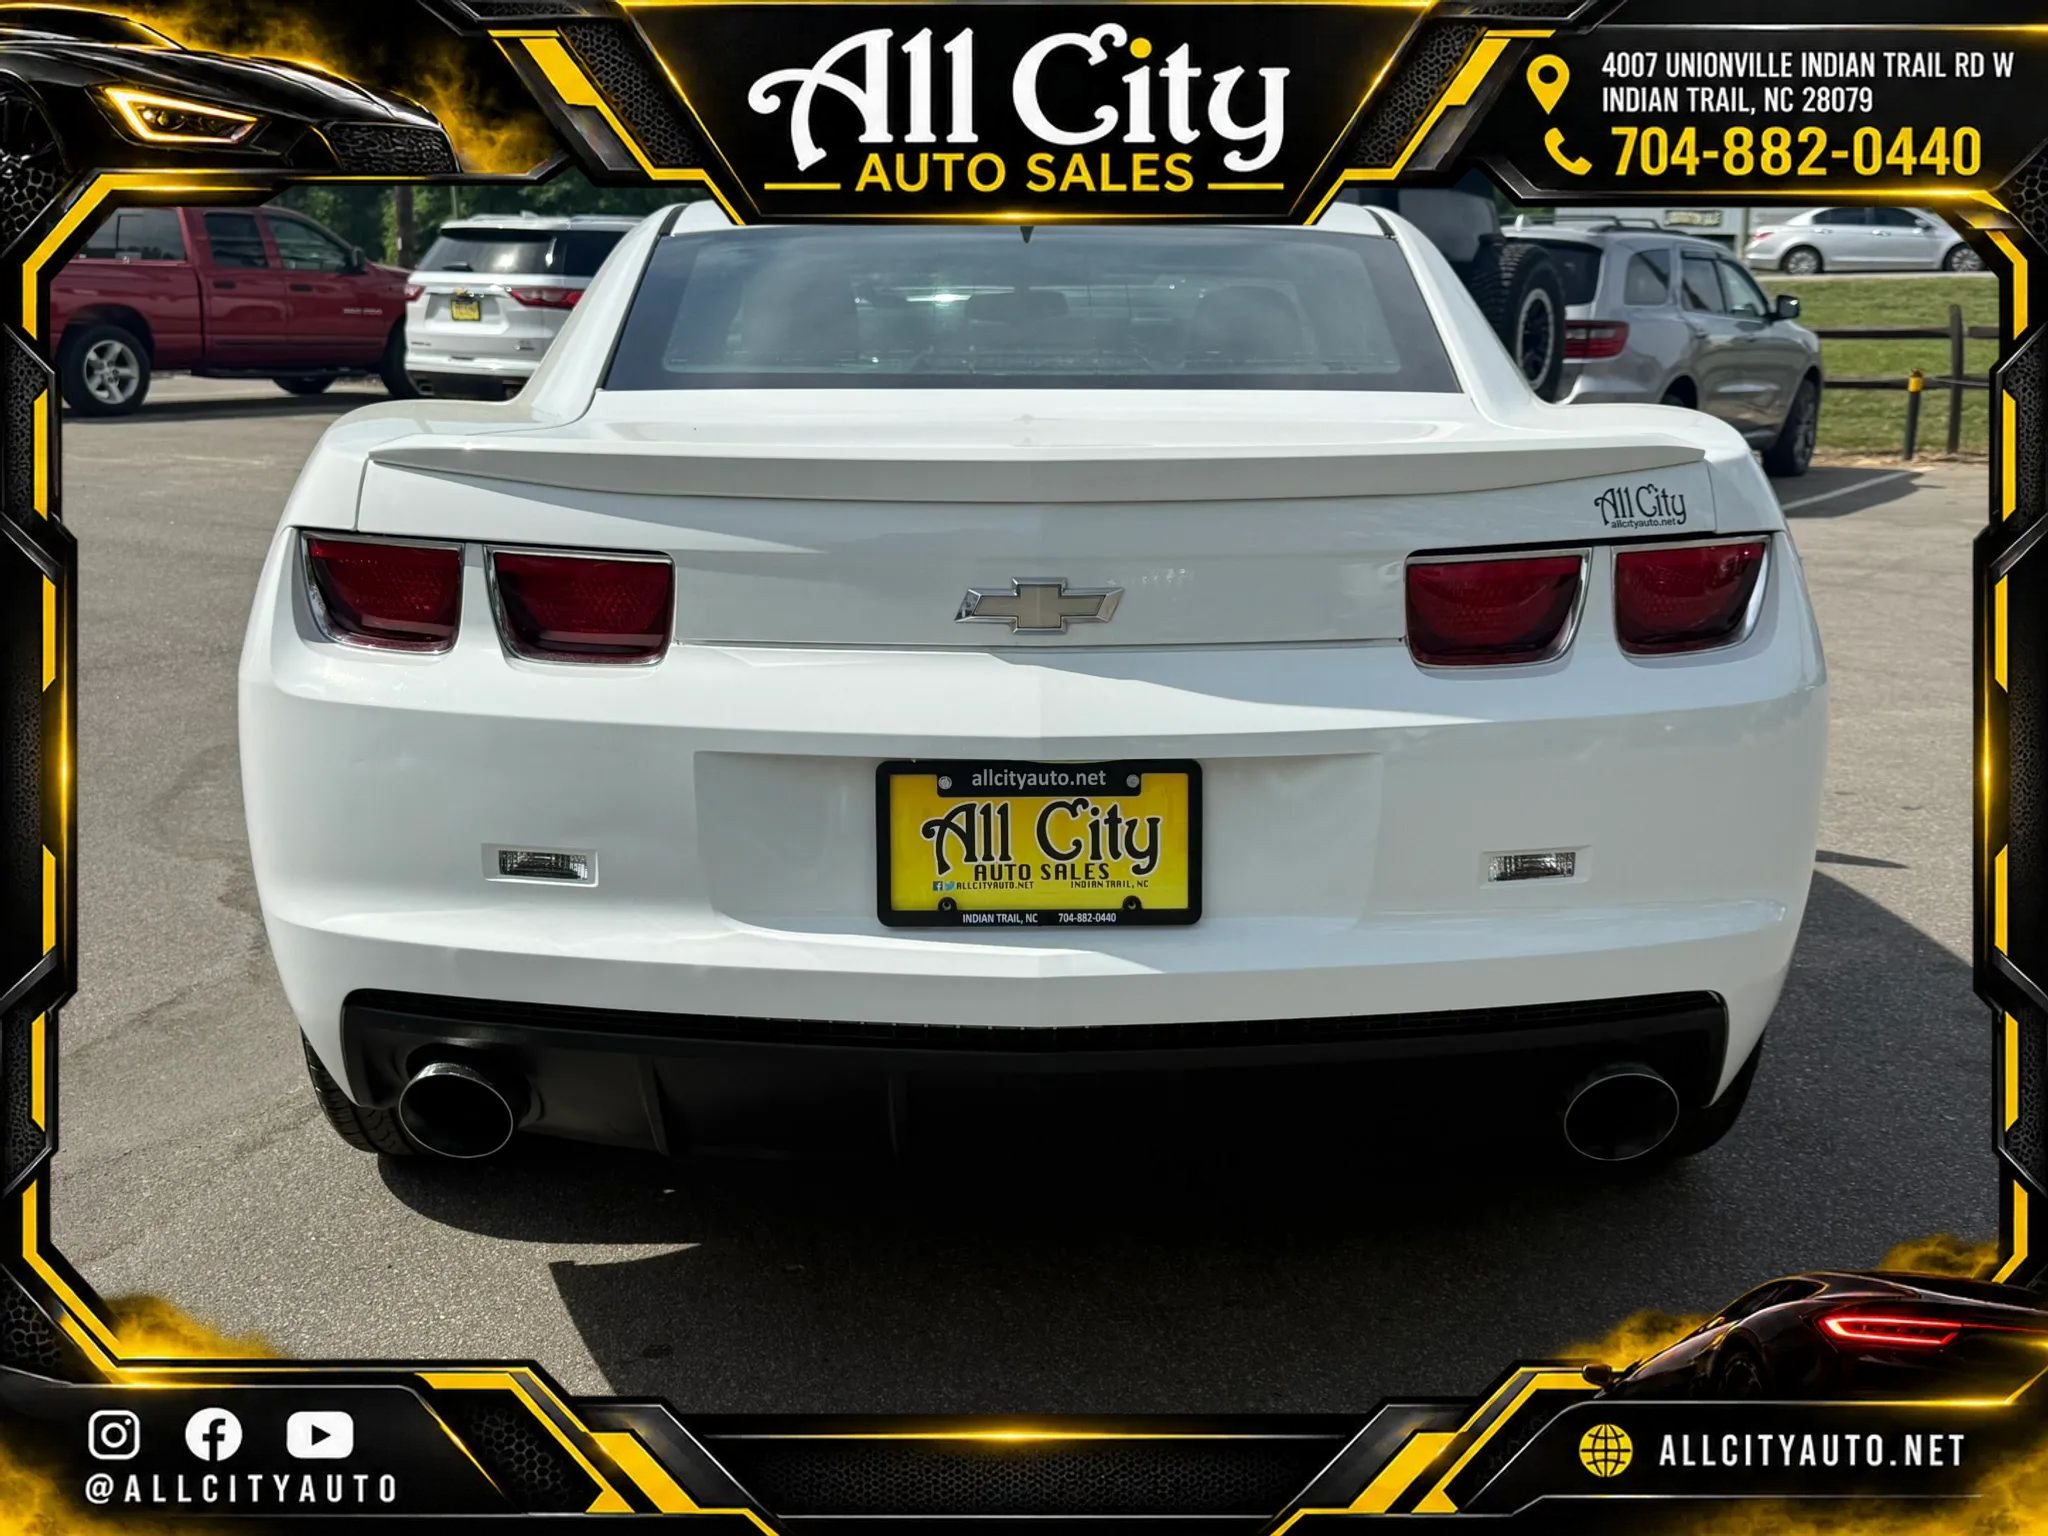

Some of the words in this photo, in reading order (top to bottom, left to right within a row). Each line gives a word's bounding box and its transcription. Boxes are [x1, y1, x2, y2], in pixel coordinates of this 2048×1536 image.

[1594, 487, 1634, 525] All
[1636, 483, 1686, 525] City
[1611, 518, 1677, 530] allcityauto.net
[971, 769, 1107, 790] allcityauto.net
[921, 802, 1012, 875] All
[1037, 798, 1161, 875] City
[974, 864, 1031, 881] AUTO
[1040, 863, 1109, 880] SALES
[956, 881, 1034, 890] ALLCITYAUTO.NET
[1071, 880, 1103, 889] INDIAN
[1106, 880, 1135, 889] TRAIL,
[1137, 880, 1149, 888] NC
[962, 913, 994, 924] INDIAN
[996, 913, 1024, 925] TRAIL,
[1026, 913, 1038, 923] NC
[1058, 912, 1117, 923] 704-882-0440
